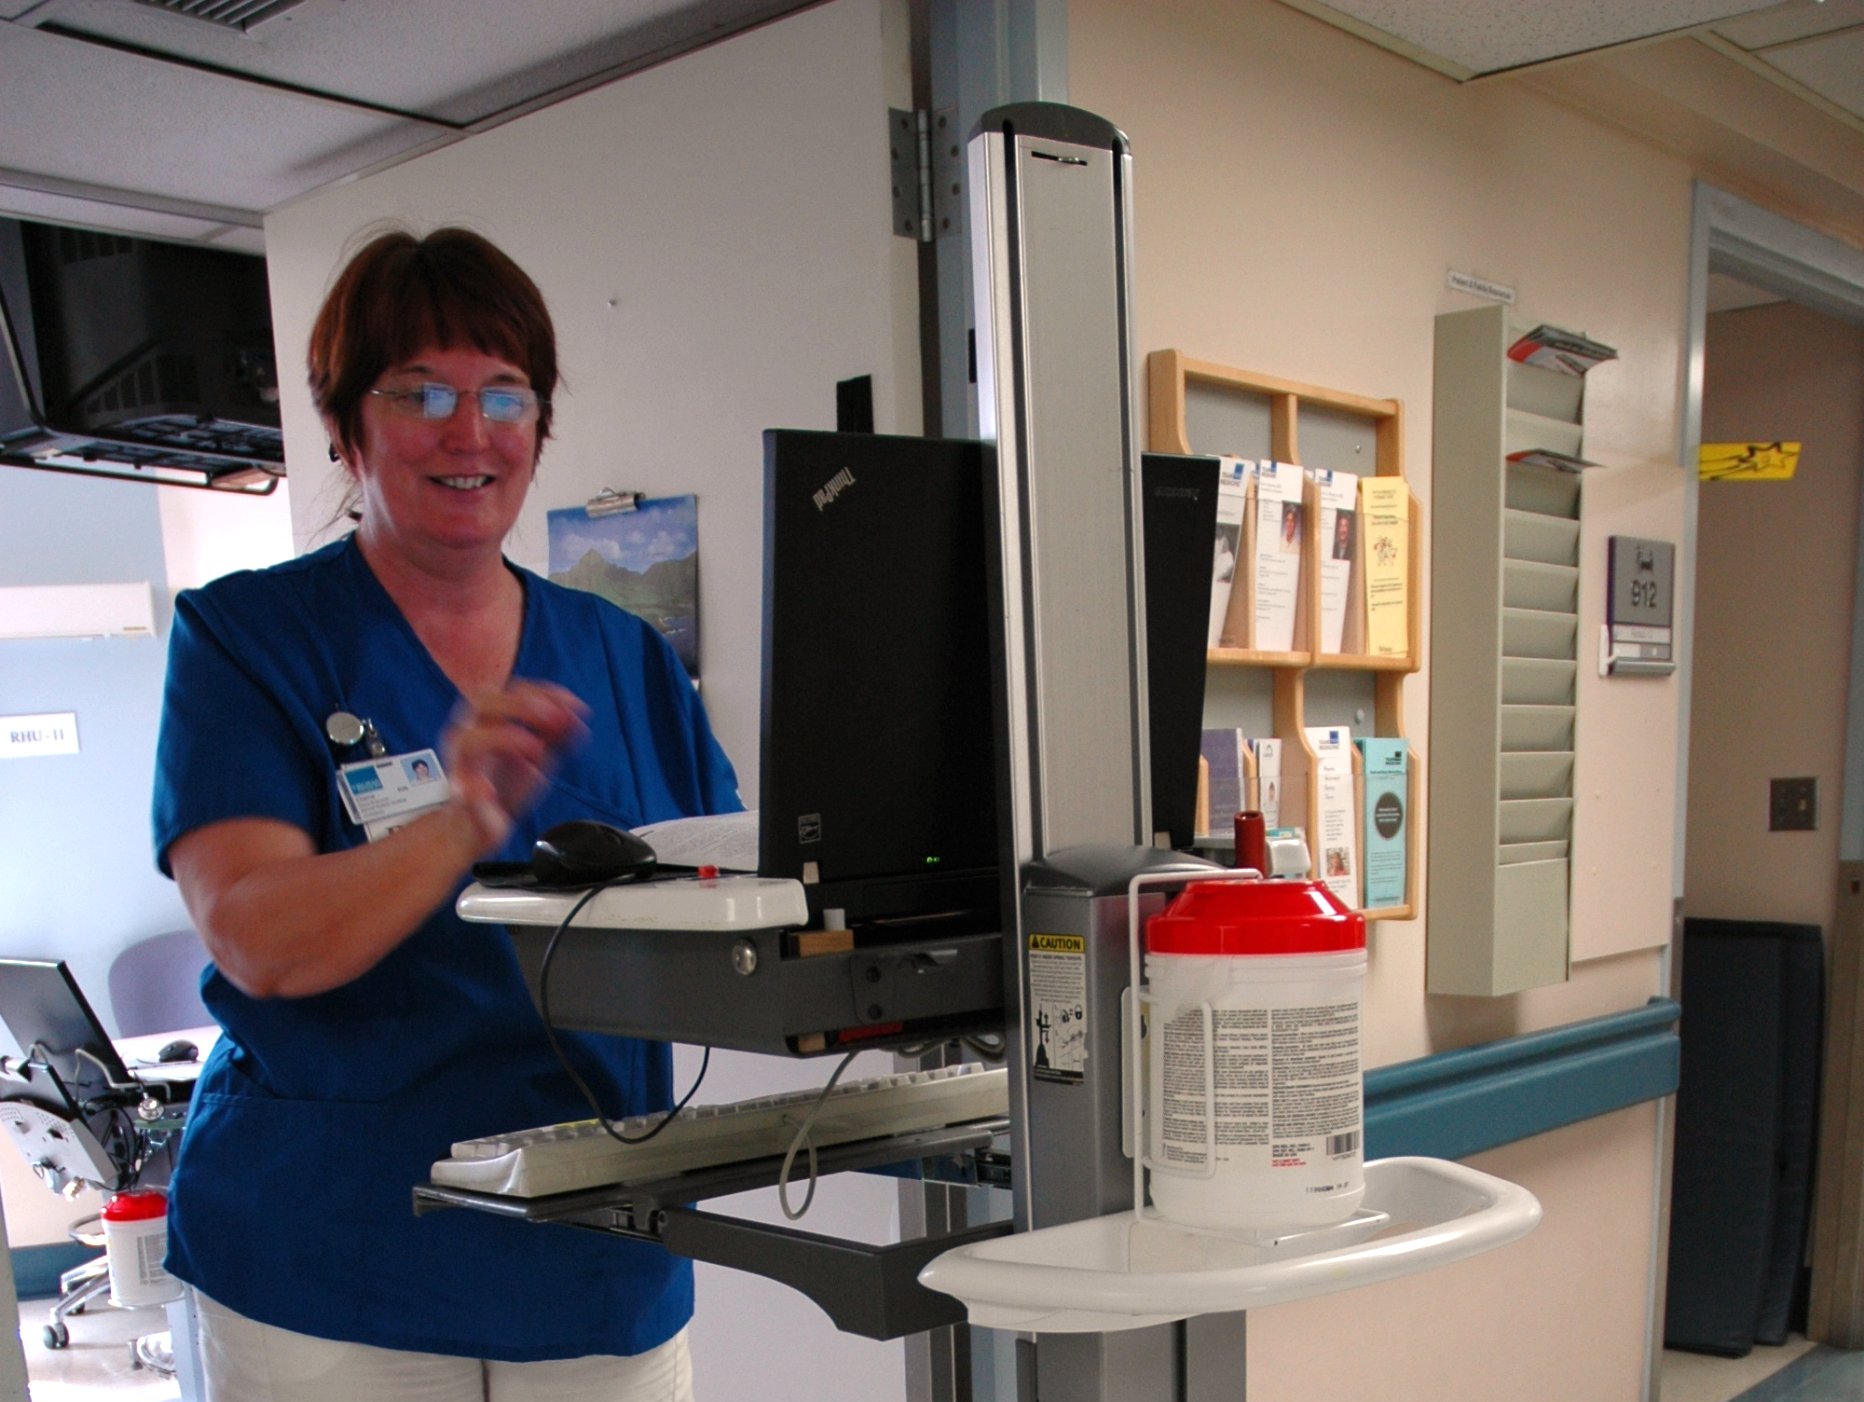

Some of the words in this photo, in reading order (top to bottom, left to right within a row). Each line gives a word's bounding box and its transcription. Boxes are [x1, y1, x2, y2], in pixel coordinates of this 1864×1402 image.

[812, 466, 856, 511] ThinkPad
[1631, 579, 1657, 608] 912
[10, 730, 42, 743] RHU
[1040, 936, 1081, 950] CAUTION
